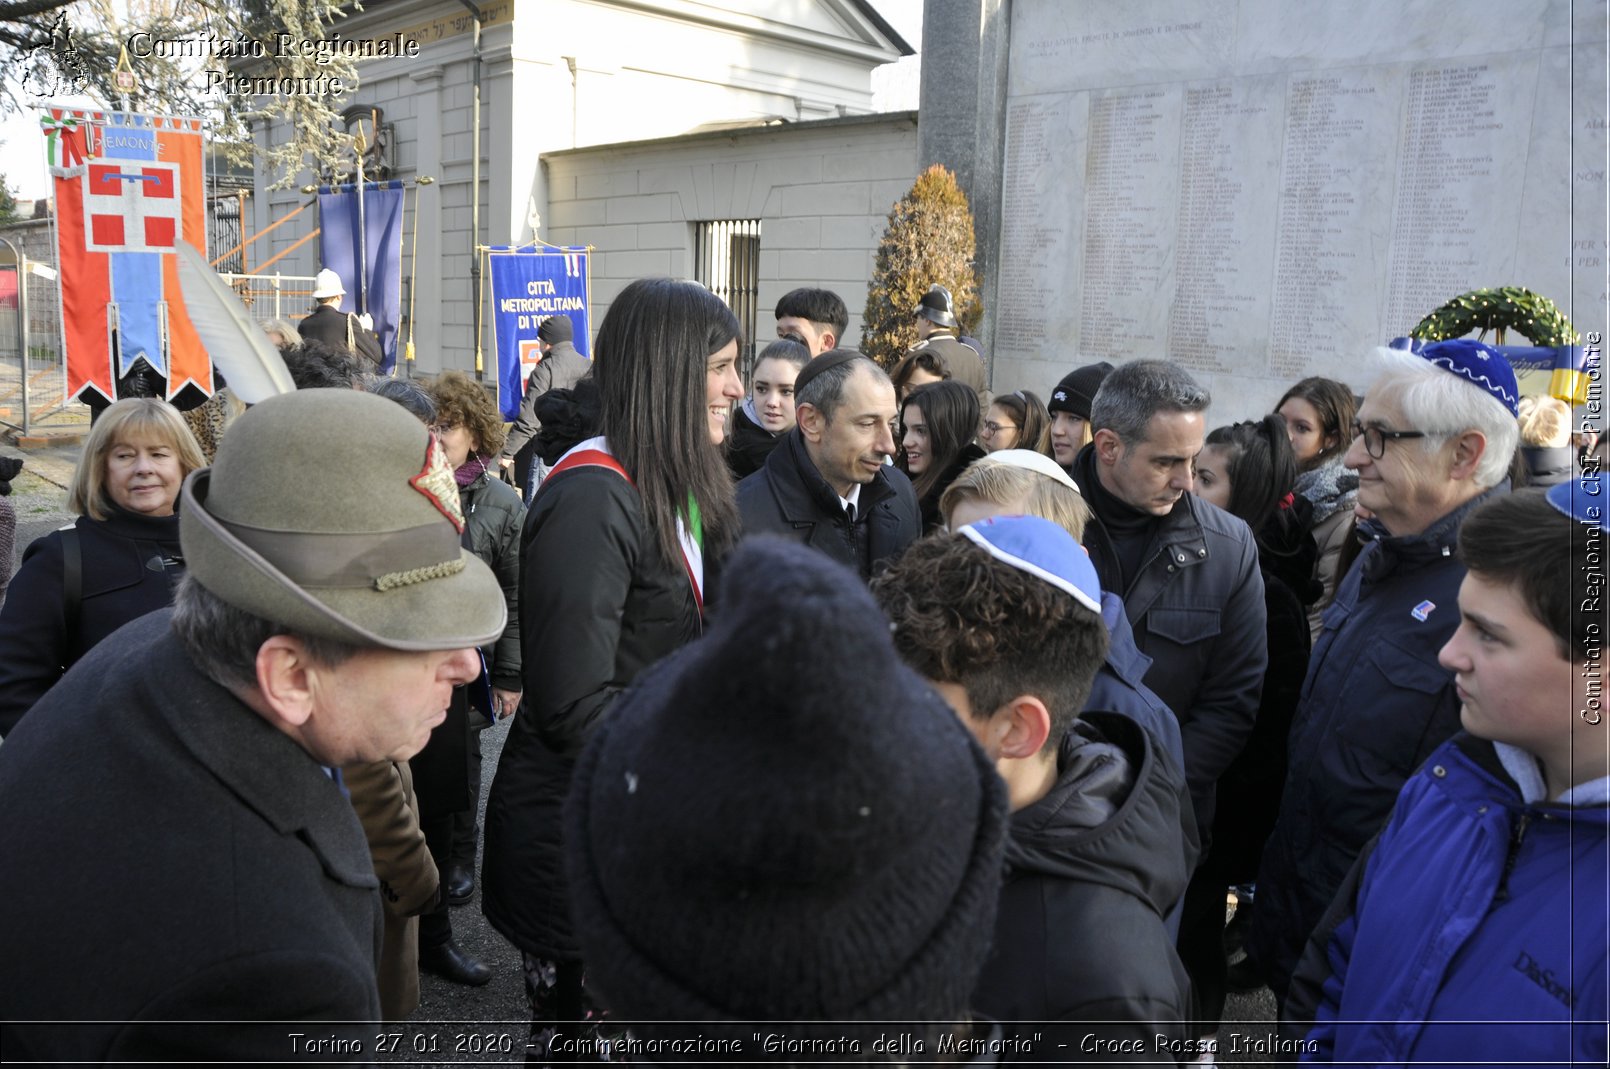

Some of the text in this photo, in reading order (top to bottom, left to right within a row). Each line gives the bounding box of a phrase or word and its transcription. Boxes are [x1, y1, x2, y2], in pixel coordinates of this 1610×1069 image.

[95, 136, 165, 154] PIEMONTE
[1576, 171, 1604, 182] NON
[528, 279, 556, 295] CITTÀ
[501, 297, 584, 312] METROPOLITANA
[518, 315, 529, 329] DI
